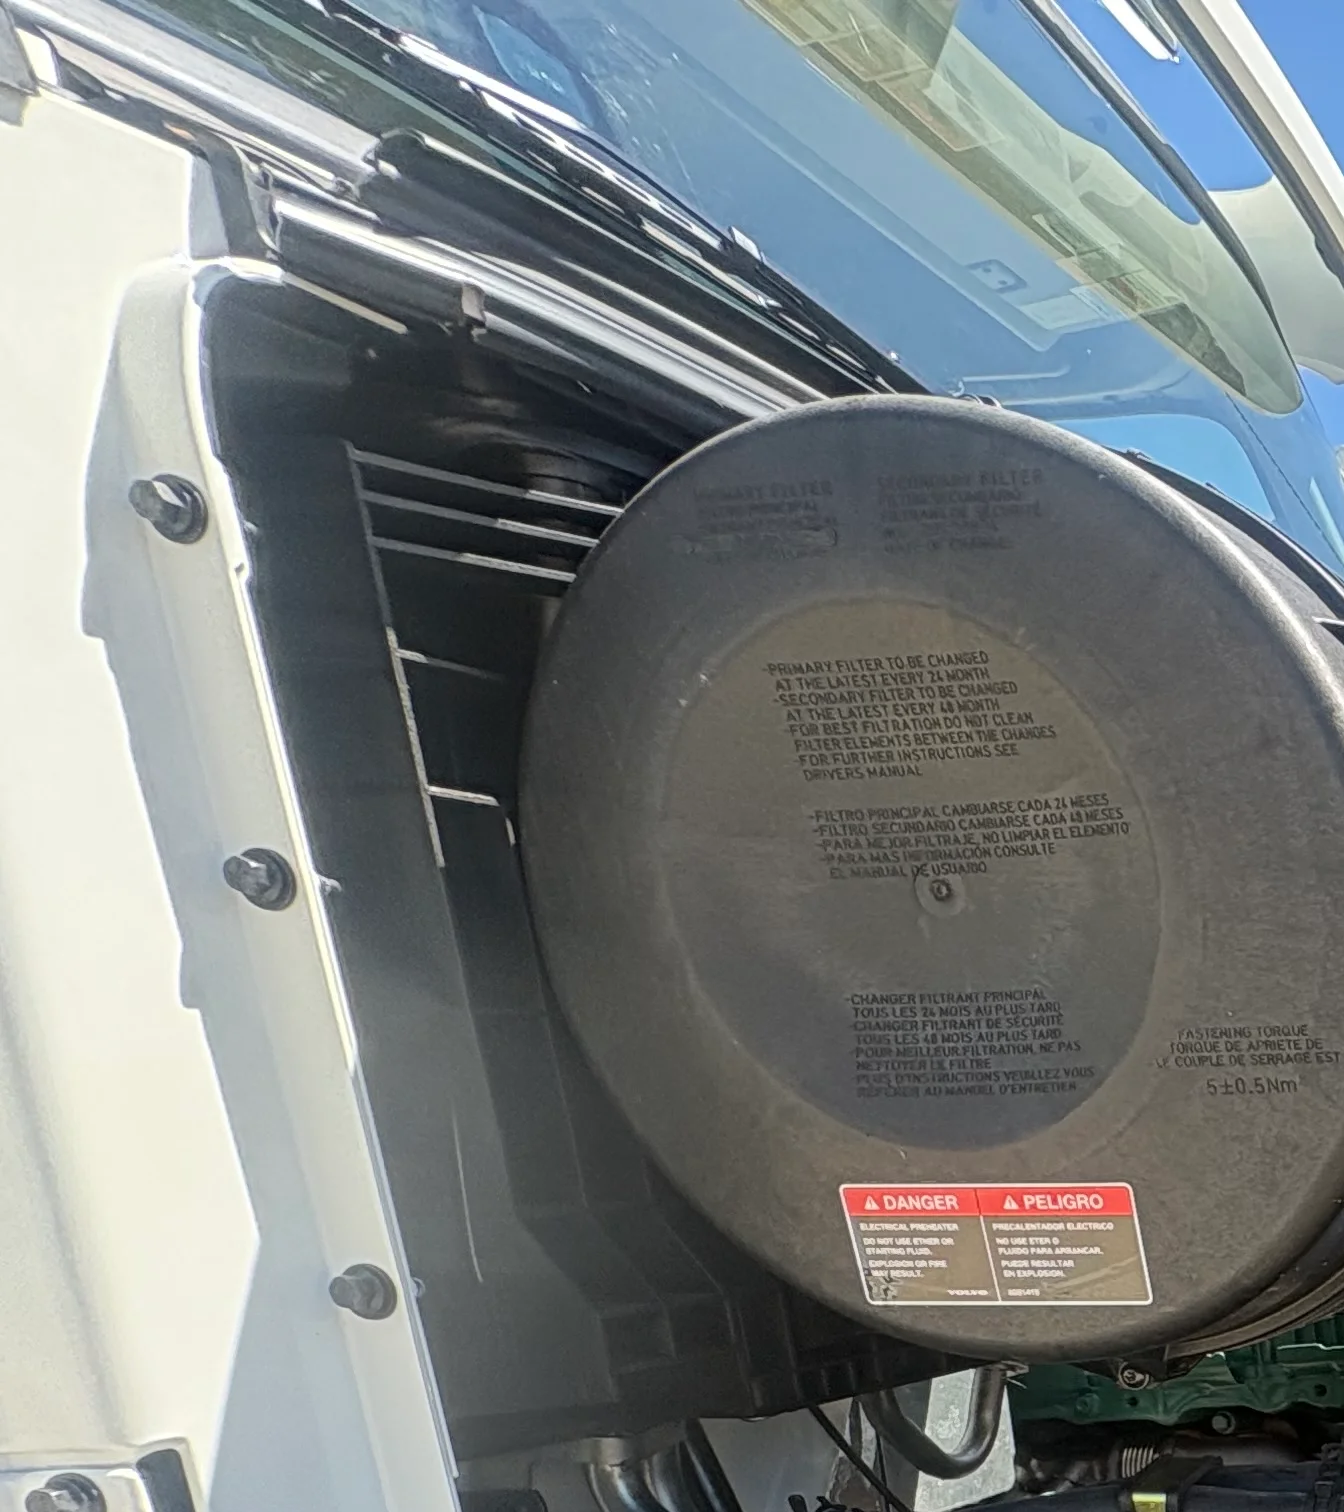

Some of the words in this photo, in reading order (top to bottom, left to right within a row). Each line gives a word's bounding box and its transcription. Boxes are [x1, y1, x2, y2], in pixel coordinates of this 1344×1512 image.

[835, 658, 884, 673] FILTER
[885, 656, 904, 670] TO
[906, 655, 925, 669] BE
[927, 650, 989, 667] CHANGED
[775, 679, 792, 692] AT
[796, 677, 826, 690] THE
[827, 674, 877, 689] LATEST
[881, 671, 924, 686] EVERY
[945, 667, 990, 682] MONTH
[869, 687, 916, 702] FILTER
[917, 686, 936, 699] TO
[937, 685, 957, 699] BE
[958, 681, 1018, 697] CHANGED
[786, 709, 802, 722] AT
[808, 707, 837, 720] THE
[840, 705, 888, 720] LATEST
[893, 702, 935, 717] EVERY
[956, 698, 1000, 713] MONTH
[823, 721, 858, 735] BEST
[862, 716, 941, 734] FILTRATION
[943, 715, 962, 729] DO
[964, 714, 989, 727] NOT
[992, 711, 1034, 726] CLEAN
[794, 738, 842, 752] FILTER
[844, 734, 912, 750] ELEMENTS
[914, 730, 974, 746] BETWEEN
[975, 729, 999, 742] THE
[1001, 725, 1057, 741] CHANGES
[832, 750, 895, 765] FURTHER
[897, 745, 992, 762] INSTRUCTIONS
[994, 743, 1019, 757] SEE
[867, 764, 923, 778] MANUAL
[867, 805, 940, 821] PRINCIPAL
[942, 800, 1015, 817] CAMBIARSE
[1017, 798, 1052, 812] CADA
[1069, 793, 1109, 808] MESES
[871, 820, 956, 835] SECUNDARIO
[958, 814, 1030, 831] CAMBIARSE
[1033, 813, 1067, 826] CADA
[1084, 807, 1124, 822] MESES
[982, 831, 999, 844] NO
[1002, 828, 1050, 843] LIMPIAR
[1052, 827, 1068, 840] EL
[1069, 821, 1129, 838] ELEMENTO
[994, 842, 1057, 858] CONSULTE
[931, 860, 987, 876] USUARIO
[919, 992, 980, 1005] FILTRANT
[984, 988, 1047, 1003] PRINCIPAL
[852, 1006, 888, 1019] TOUS
[892, 1006, 917, 1018] LES
[939, 1005, 971, 1017] MOIS
[975, 1004, 992, 1017] AU
[995, 1003, 1026, 1016] PLUS
[922, 1018, 981, 1031] FILTRANT
[986, 1018, 1002, 1030] DE
[1178, 1026, 1252, 1040] FASTENING
[1257, 1024, 1309, 1037] TORQUE
[894, 1033, 920, 1045] LES
[941, 1031, 973, 1044] MOIS
[977, 1030, 994, 1043] AU
[997, 1029, 1029, 1042] PLUS
[1032, 1027, 1062, 1040] TARD
[1058, 1040, 1081, 1052] PAS
[1170, 1041, 1221, 1054] TORQUE
[1225, 1040, 1242, 1053] DE
[1305, 1038, 1323, 1050] DE
[1175, 1055, 1225, 1068] COUPLE
[1229, 1054, 1246, 1066] DE
[1250, 1052, 1311, 1065] SERRAGE
[1315, 1051, 1341, 1064] EST
[883, 1194, 959, 1210] DANGER
[1023, 1193, 1104, 1210] PELIGRO
[859, 1223, 909, 1231] ELECTRICAL
[863, 1237, 875, 1245] DO
[877, 1237, 893, 1245] NOT
[941, 1237, 954, 1245] OR
[996, 1237, 1009, 1245] NO
